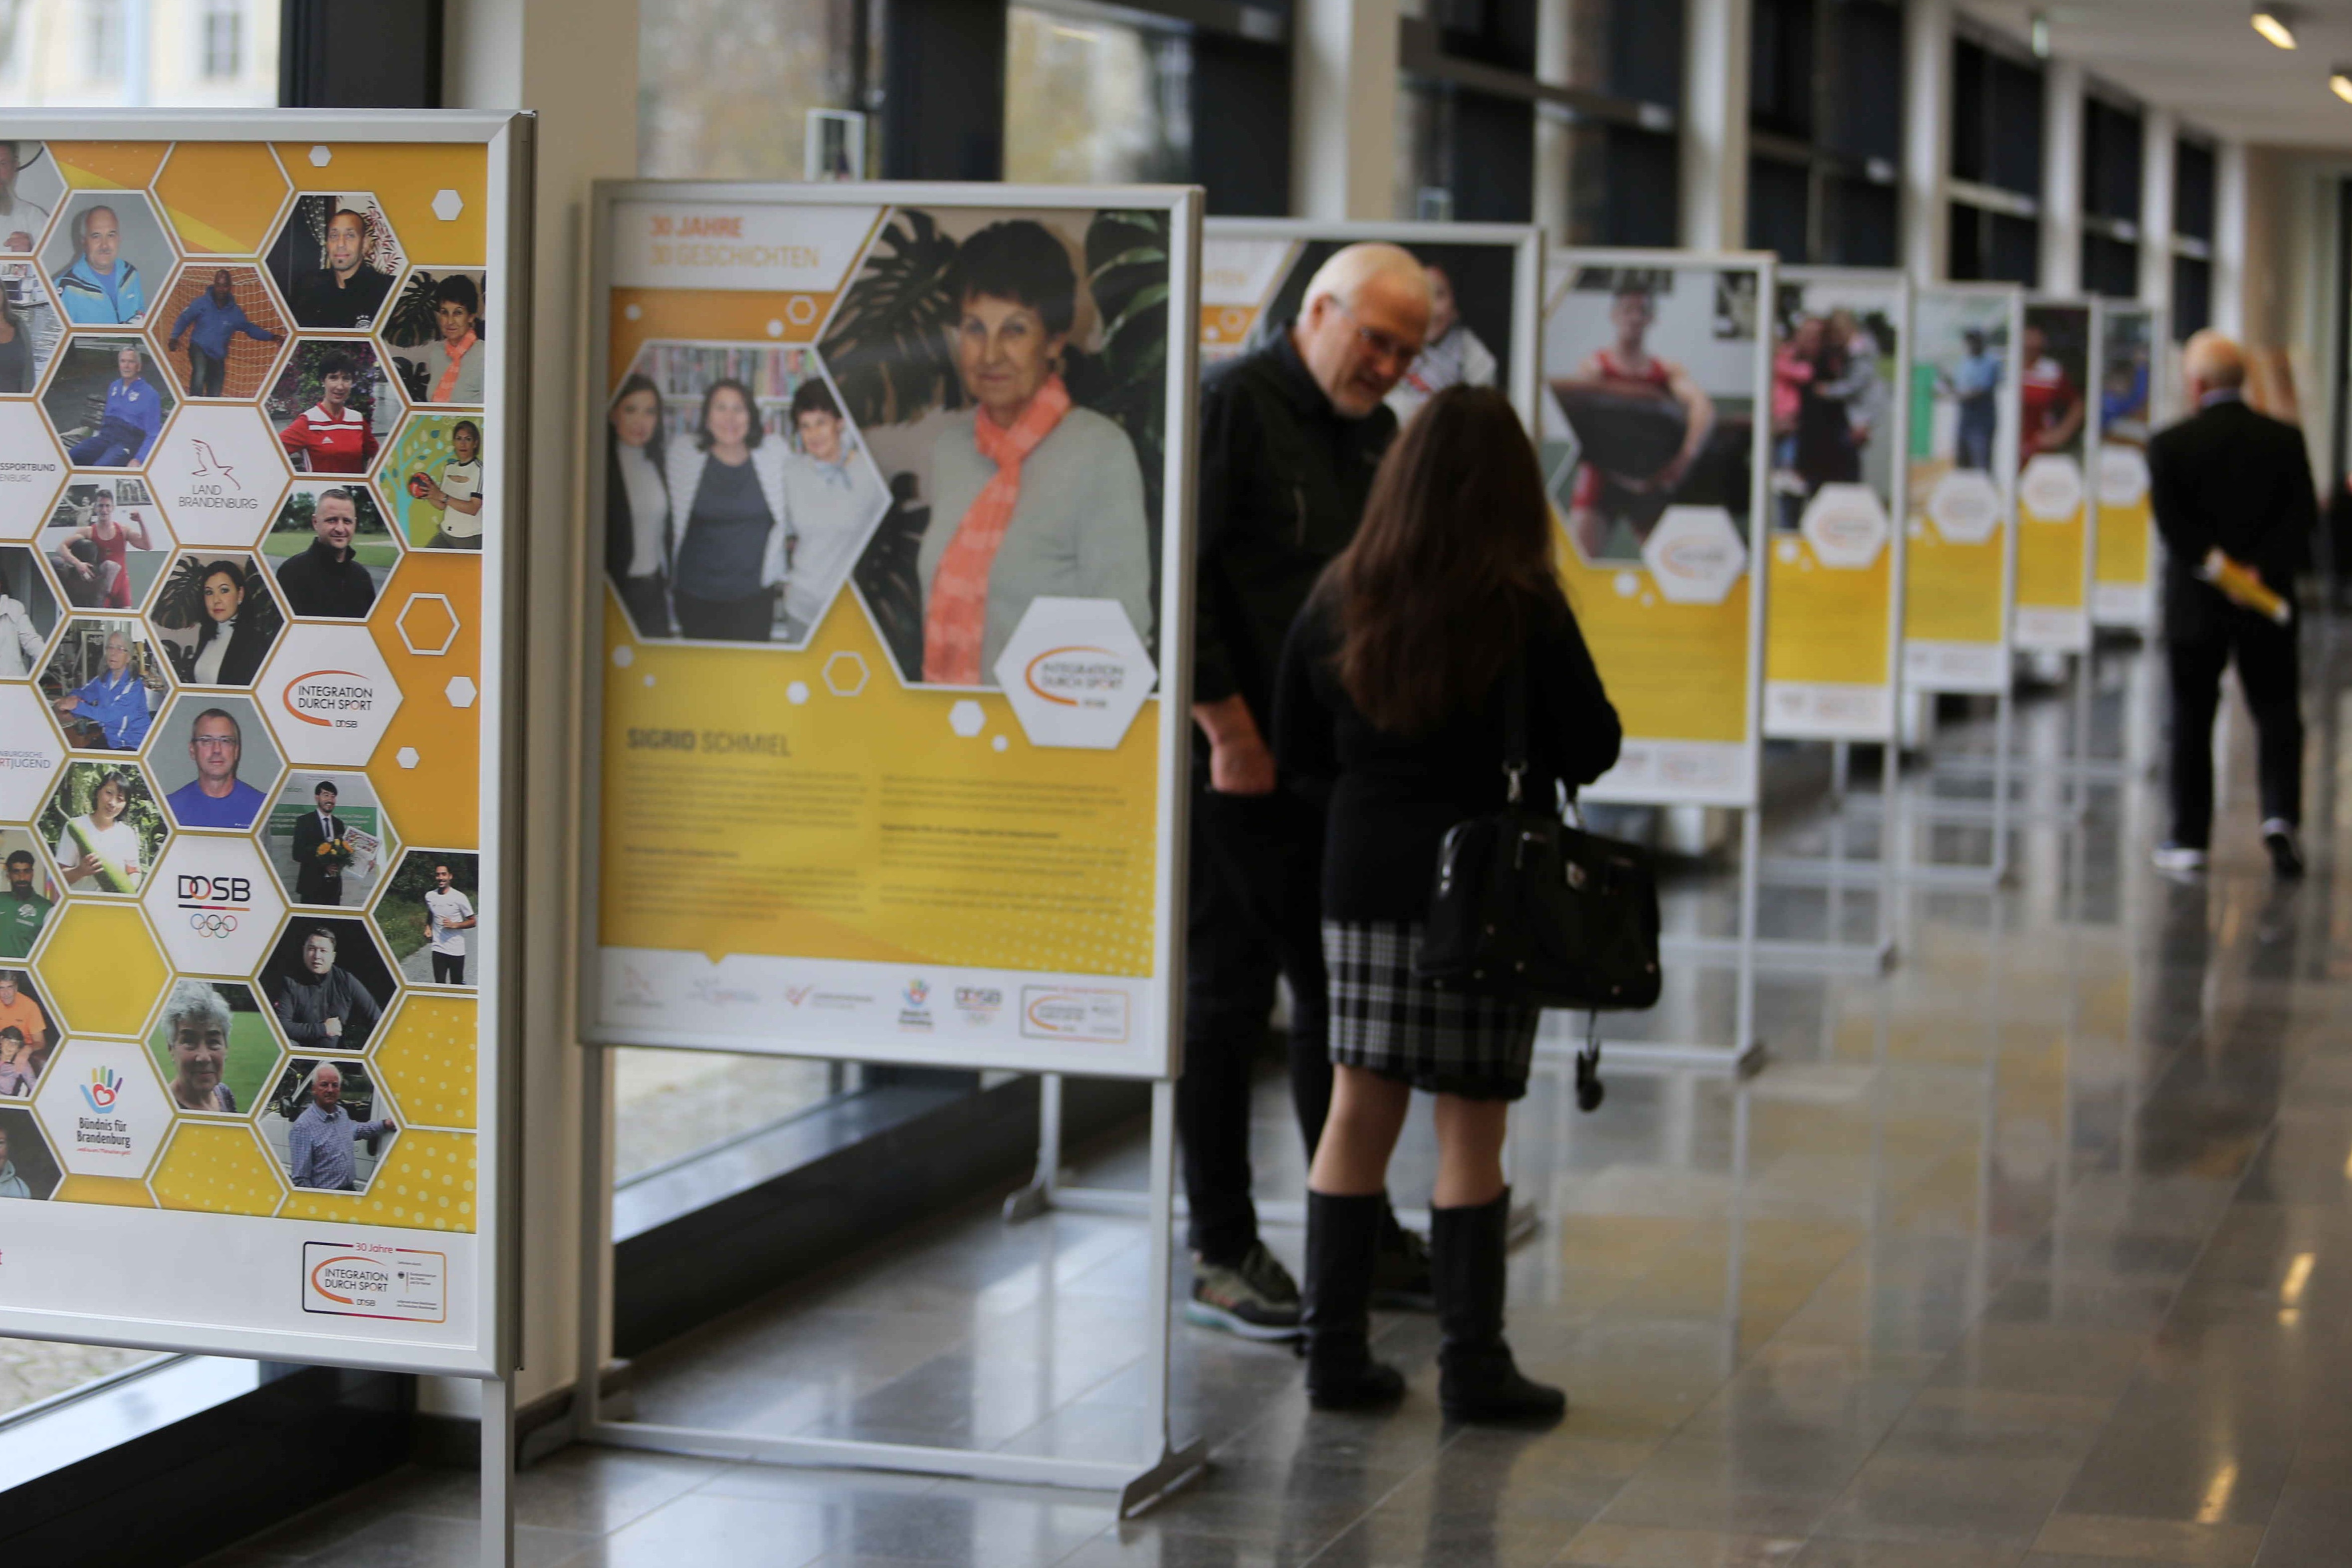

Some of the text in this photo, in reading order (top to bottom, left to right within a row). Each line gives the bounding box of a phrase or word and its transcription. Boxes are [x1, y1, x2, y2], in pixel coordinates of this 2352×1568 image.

[192, 485, 221, 495] LAND
[179, 496, 258, 509] BRANDENBURG
[299, 686, 373, 698] INTEGRATION
[299, 698, 373, 710] DURCH SPORT
[627, 728, 696, 750] SIGRID
[178, 875, 251, 902] DOSB
[79, 1117, 127, 1132] Bündnis für
[77, 1130, 131, 1148] Brandenburg
[356, 1243, 393, 1254] 30 Jahre
[325, 1268, 389, 1281] INTEGRATION
[325, 1279, 388, 1292] DURCH SPORT
